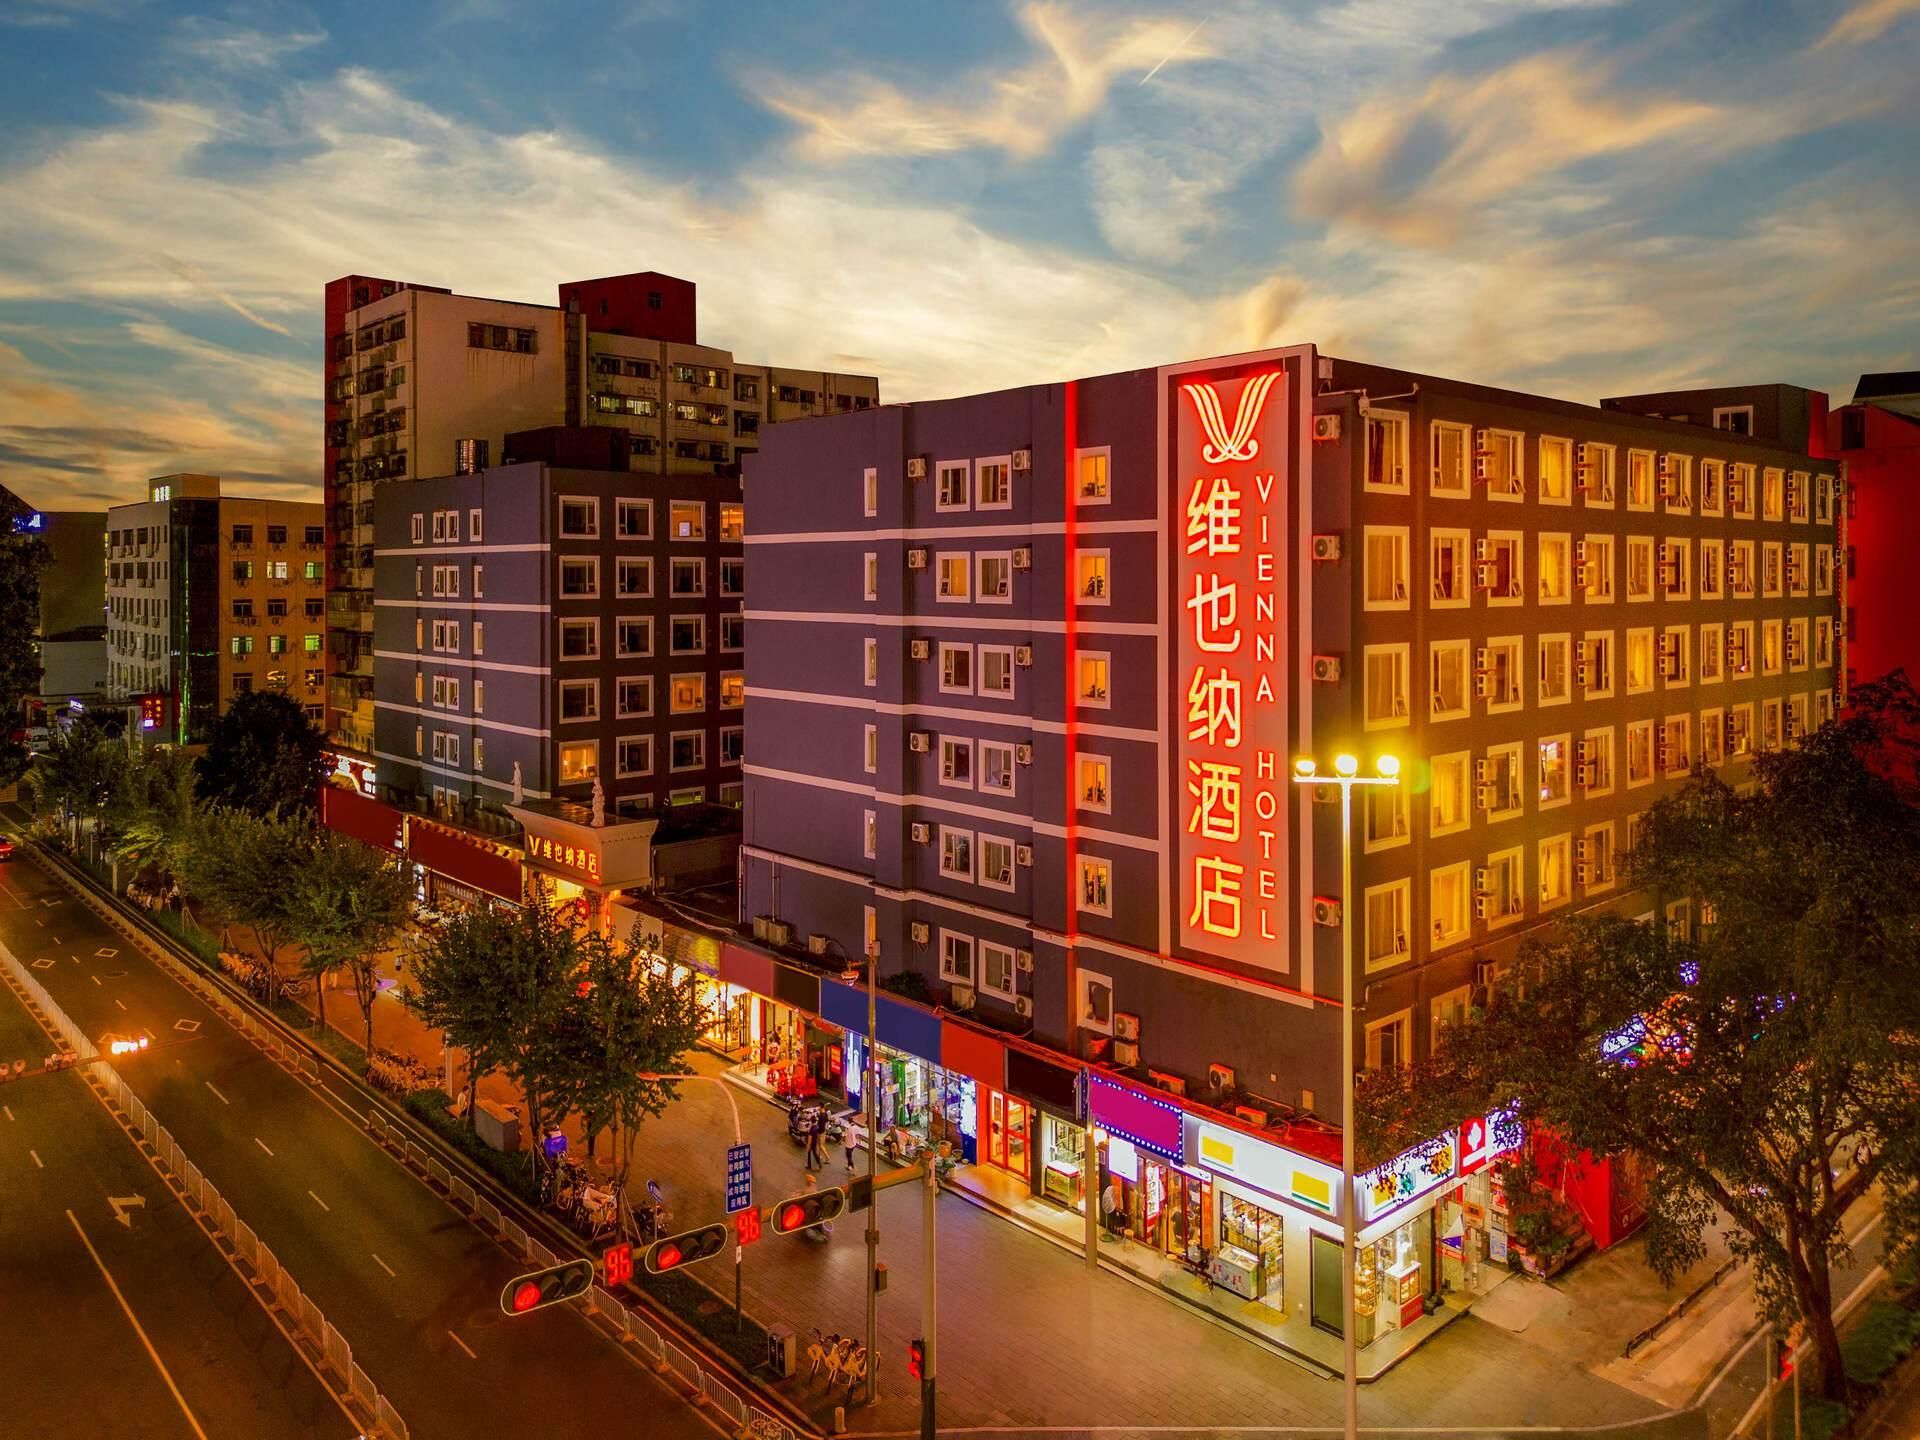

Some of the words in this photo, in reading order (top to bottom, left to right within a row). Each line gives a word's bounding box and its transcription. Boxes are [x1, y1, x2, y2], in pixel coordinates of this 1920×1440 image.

[1255, 475, 1275, 704] VIENNA
[1186, 477, 1244, 939] 维也纳酒店
[543, 839, 597, 874] 维也纳酒店
[1255, 751, 1277, 940] HOTEL
[607, 1246, 631, 1286] 96
[737, 1209, 760, 1245] 96
